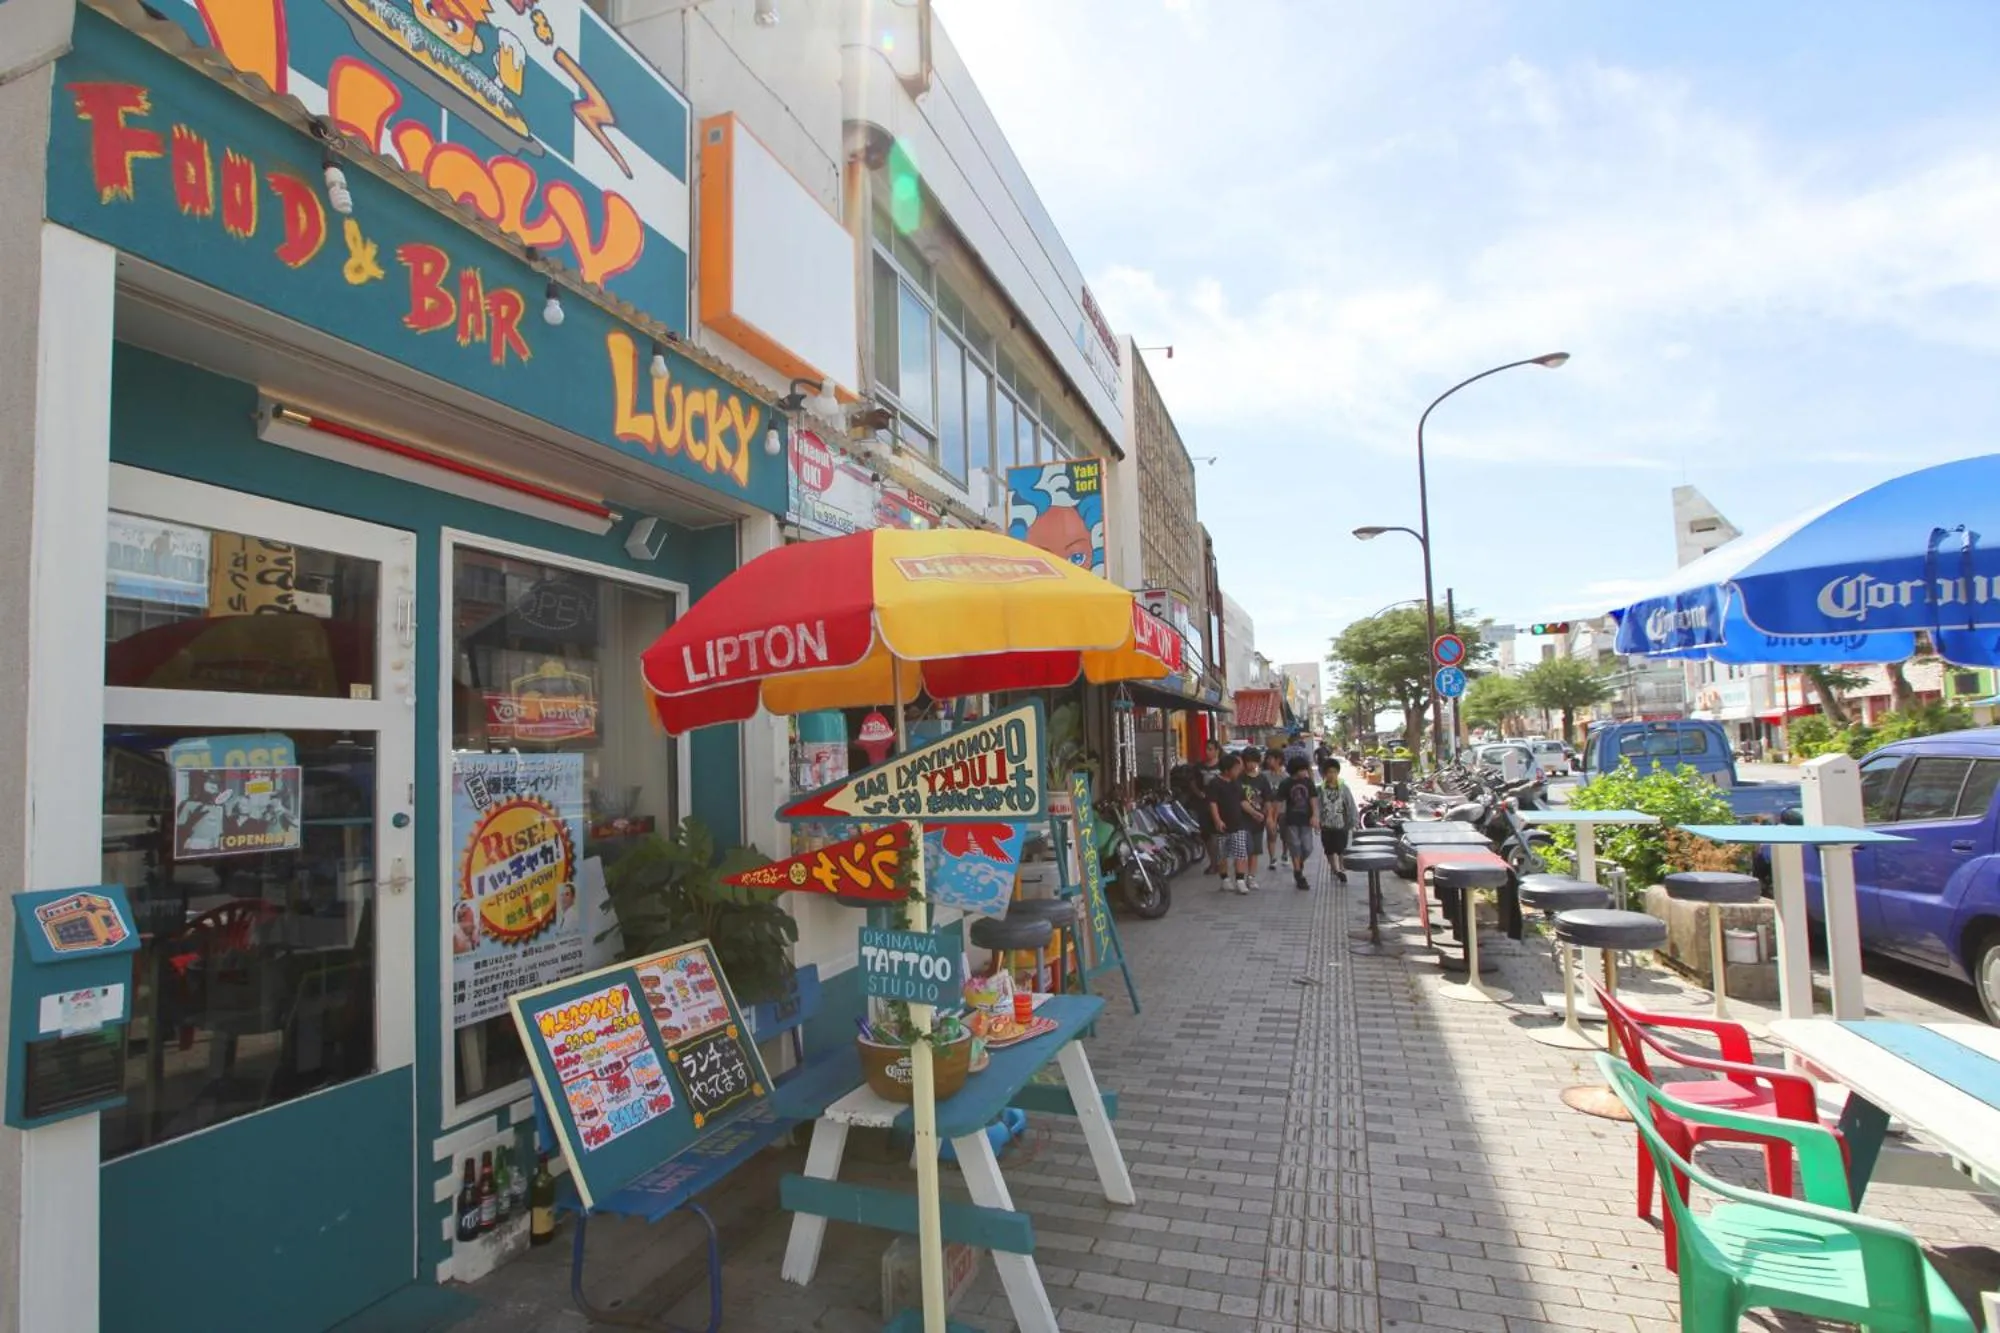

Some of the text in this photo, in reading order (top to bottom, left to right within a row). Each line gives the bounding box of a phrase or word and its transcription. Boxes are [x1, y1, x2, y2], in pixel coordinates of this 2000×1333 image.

[64, 82, 532, 364] FOOD & BAR
[606, 330, 761, 488] LUCKY
[1073, 464, 1099, 479] Yaki
[1075, 477, 1097, 492] tori
[914, 561, 1039, 576] Lipton
[1817, 573, 2000, 621] Coron
[682, 620, 829, 684] LIPTON
[1441, 674, 1454, 693] P
[480, 820, 548, 866] RISE!
[863, 931, 938, 953] OKINAWA
[861, 946, 952, 982] TATTOO
[868, 975, 939, 1001] STUDIO
[682, 1041, 723, 1078] ランチ
[885, 1063, 913, 1079] Coro
[689, 1058, 749, 1107] やってます
